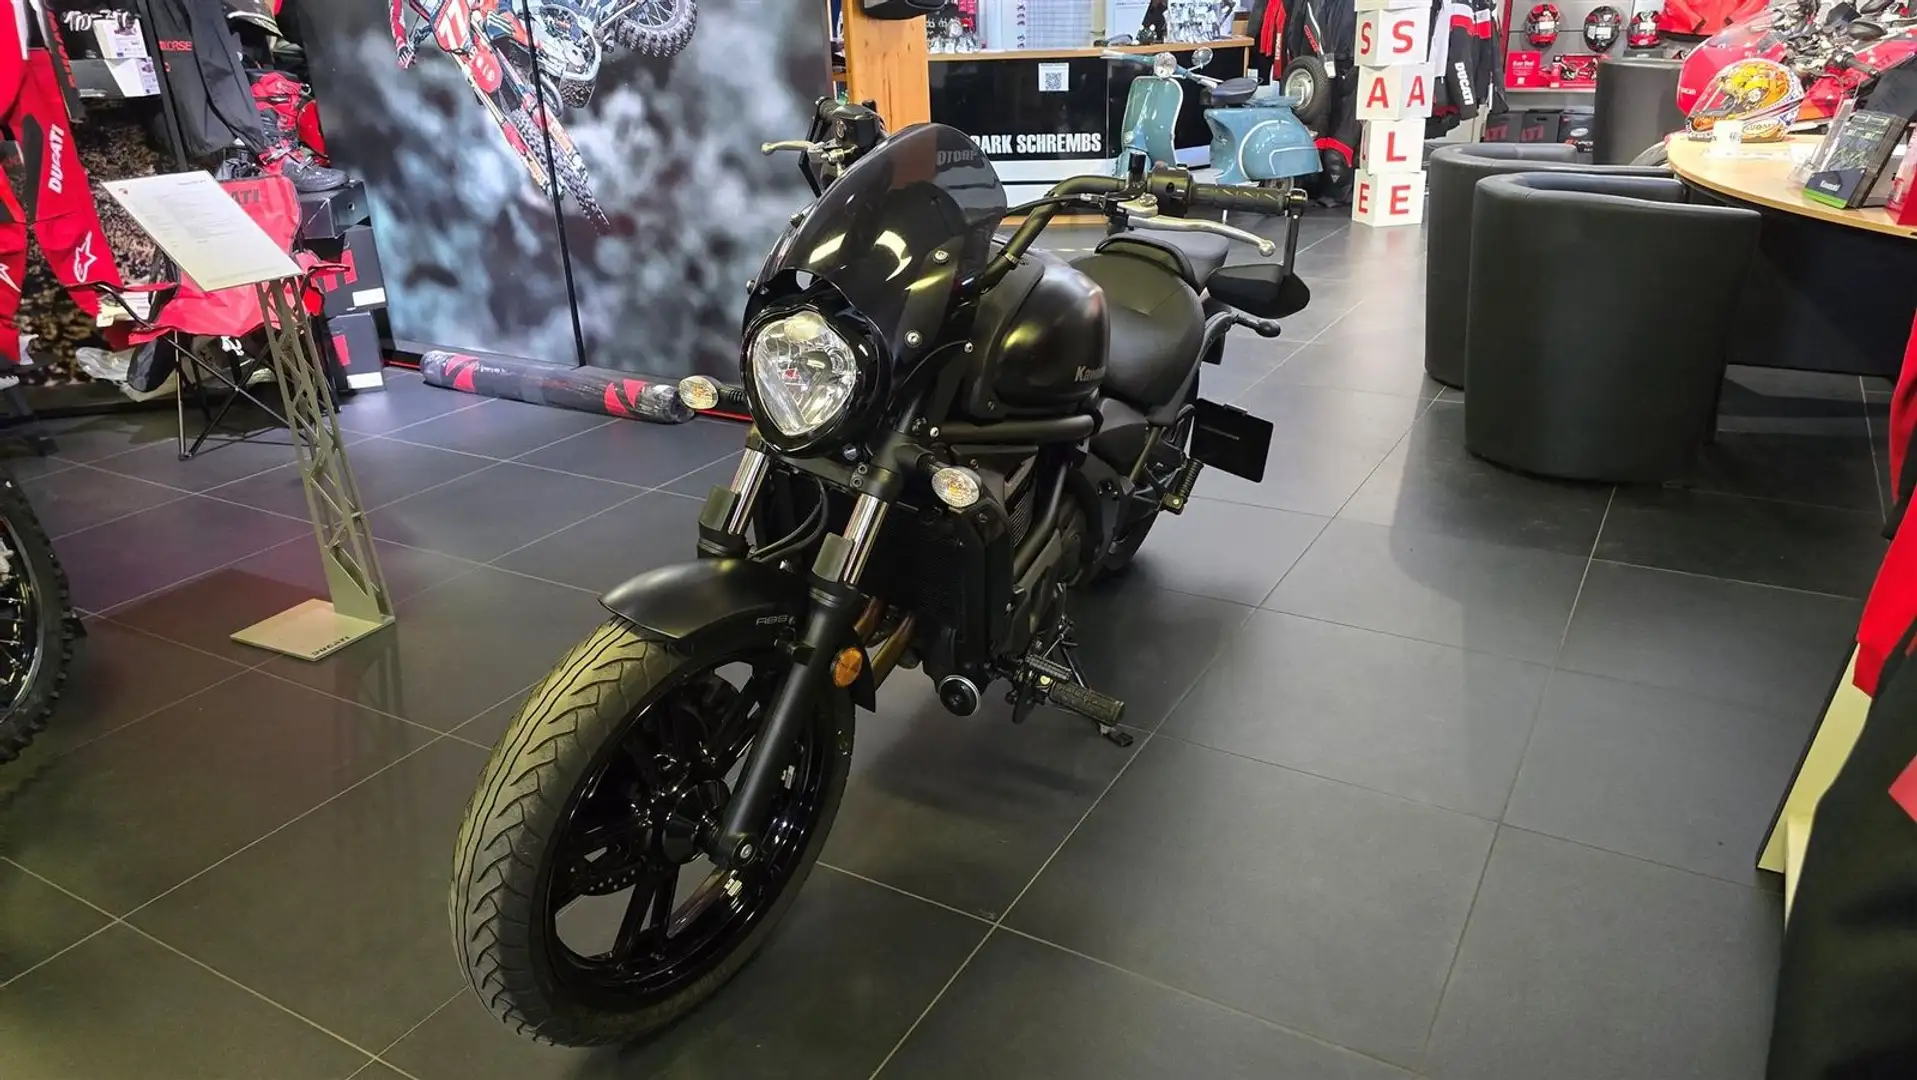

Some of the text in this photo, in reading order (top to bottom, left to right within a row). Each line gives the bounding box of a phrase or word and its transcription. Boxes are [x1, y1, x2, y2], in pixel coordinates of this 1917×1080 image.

[1454, 62, 1474, 106] DUCATI
[48, 123, 65, 195] DUCATI
[1016, 132, 1102, 154] SCHREMBS
